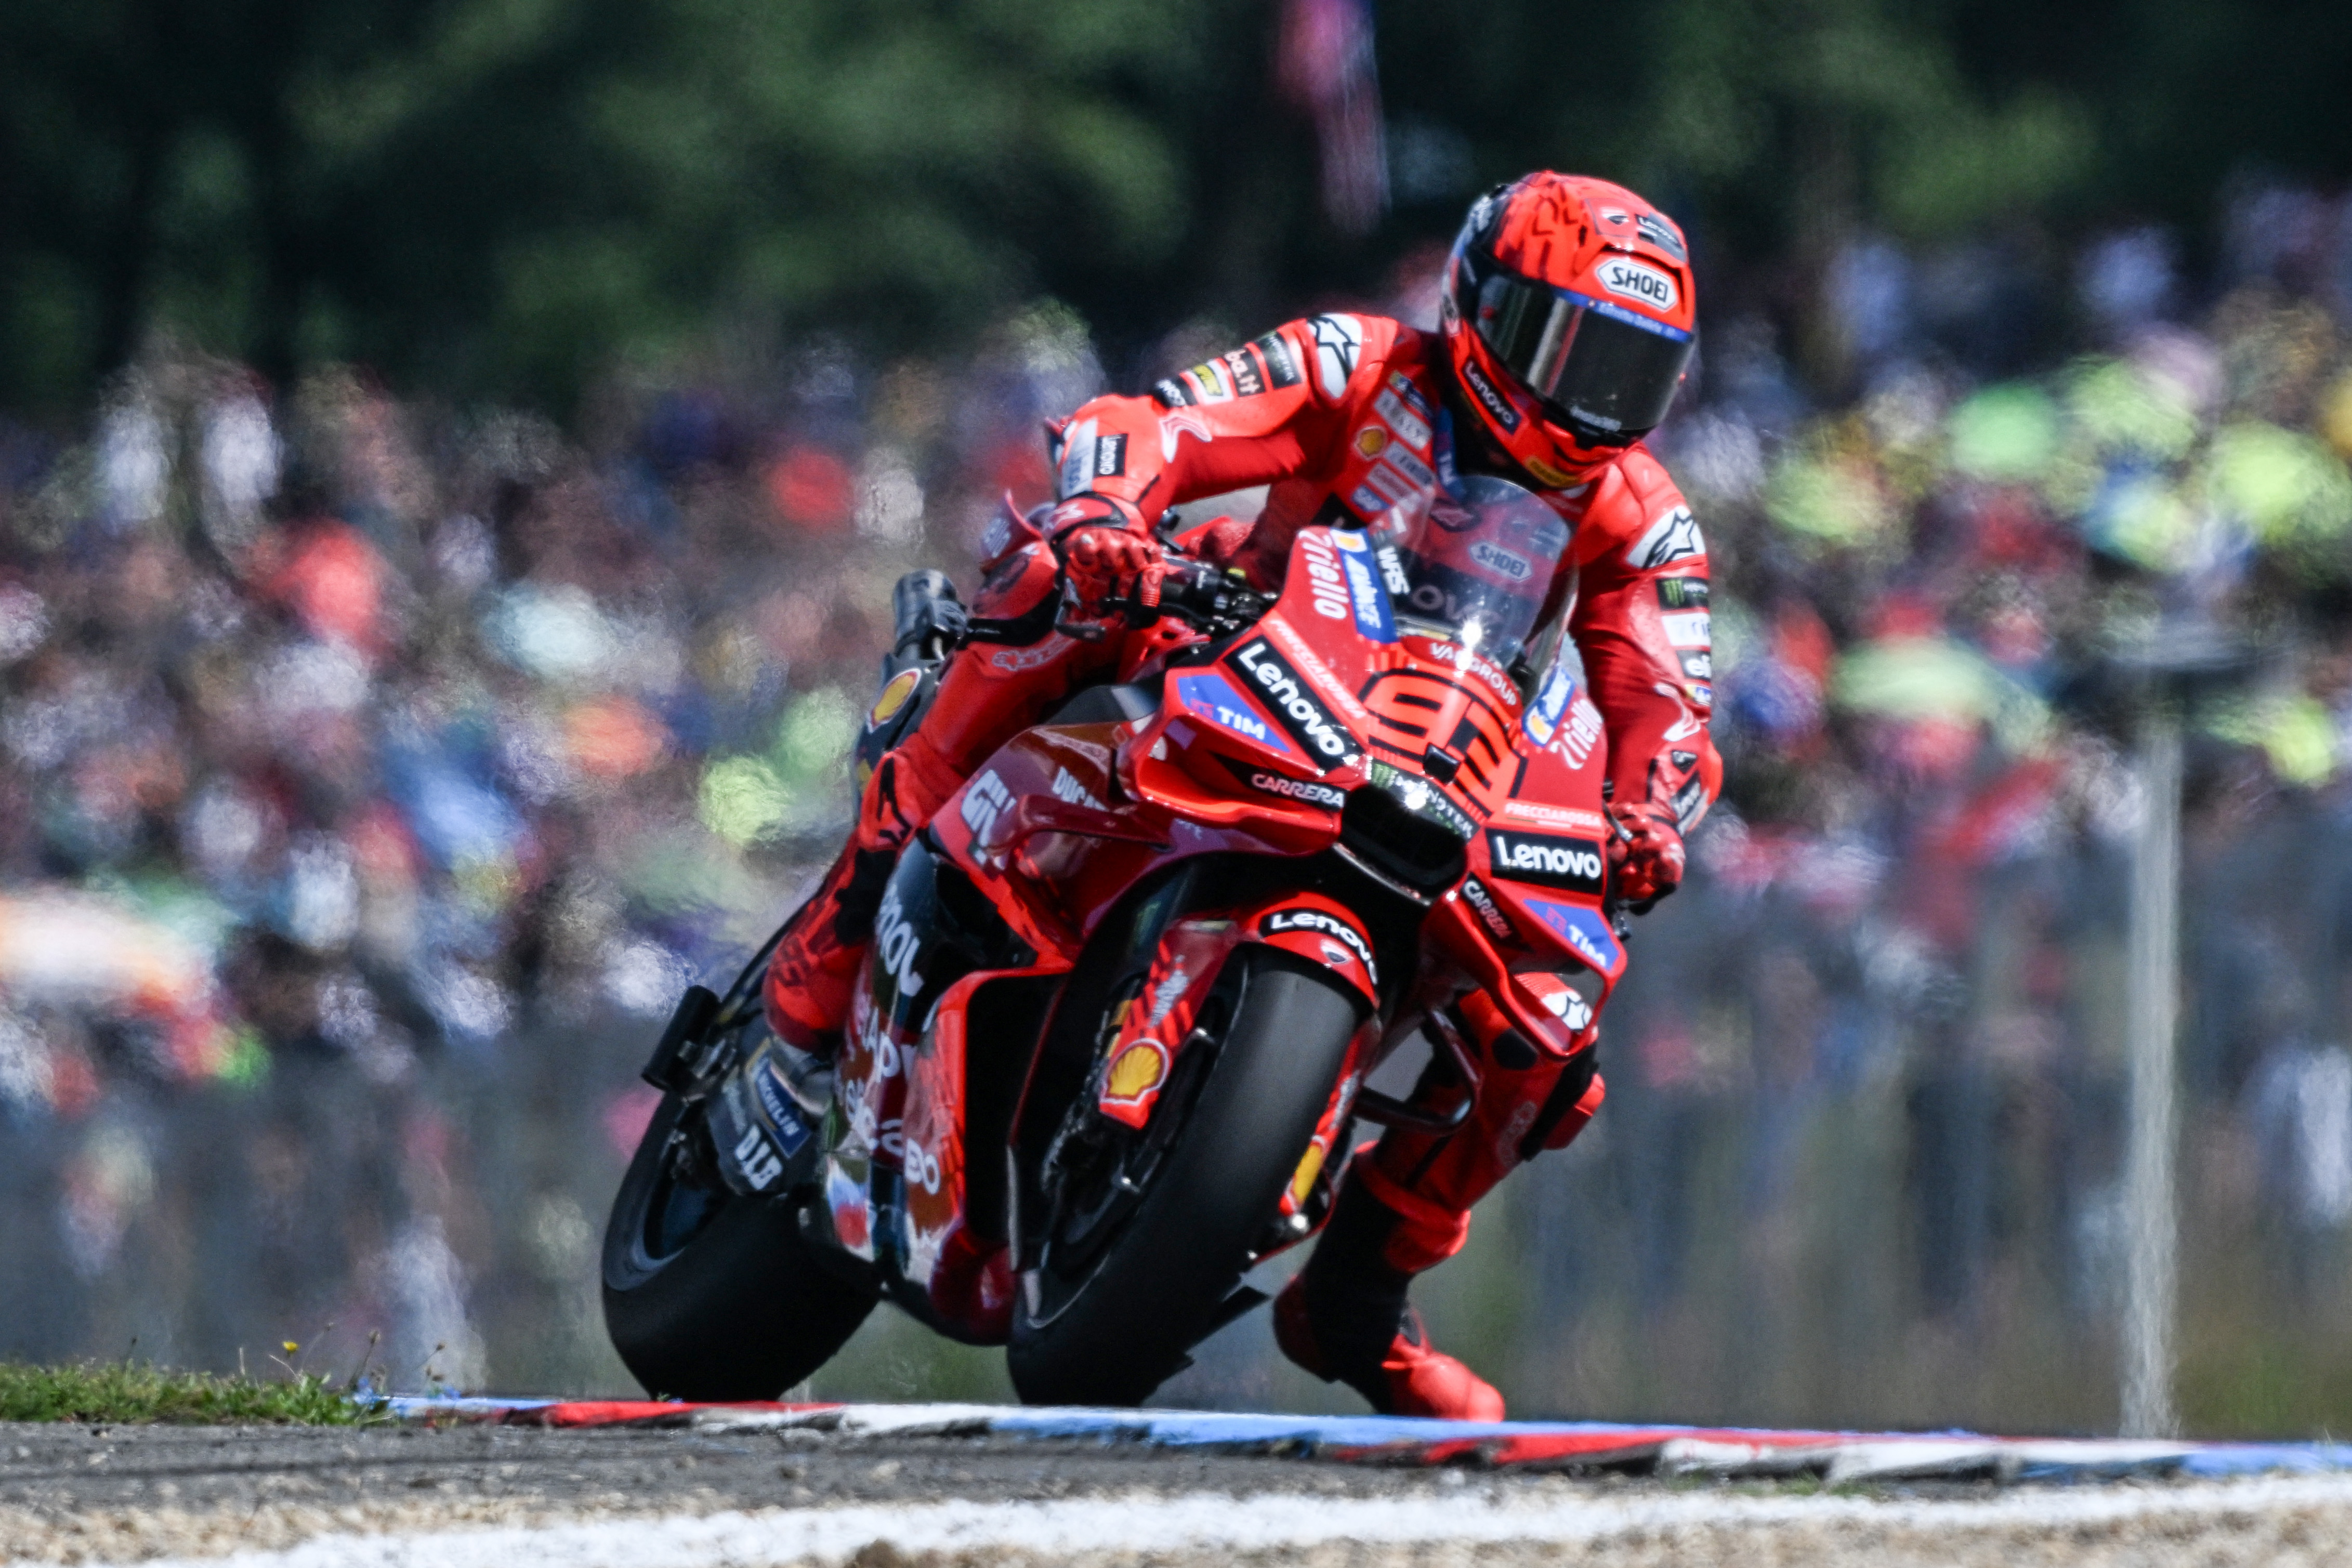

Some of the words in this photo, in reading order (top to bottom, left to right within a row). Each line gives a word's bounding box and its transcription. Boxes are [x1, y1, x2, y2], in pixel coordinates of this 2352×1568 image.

[1611, 267, 1668, 302] SHOEI
[1465, 362, 1514, 425] Lenovo
[1377, 546, 1410, 595] WRS
[1479, 545, 1526, 577] SHOEI
[1238, 642, 1345, 756] Lenovo
[1217, 706, 1266, 741] TIM
[1252, 773, 1345, 809] CARRERA
[1496, 836, 1601, 879] Lenovo
[1569, 924, 1607, 968] TIM
